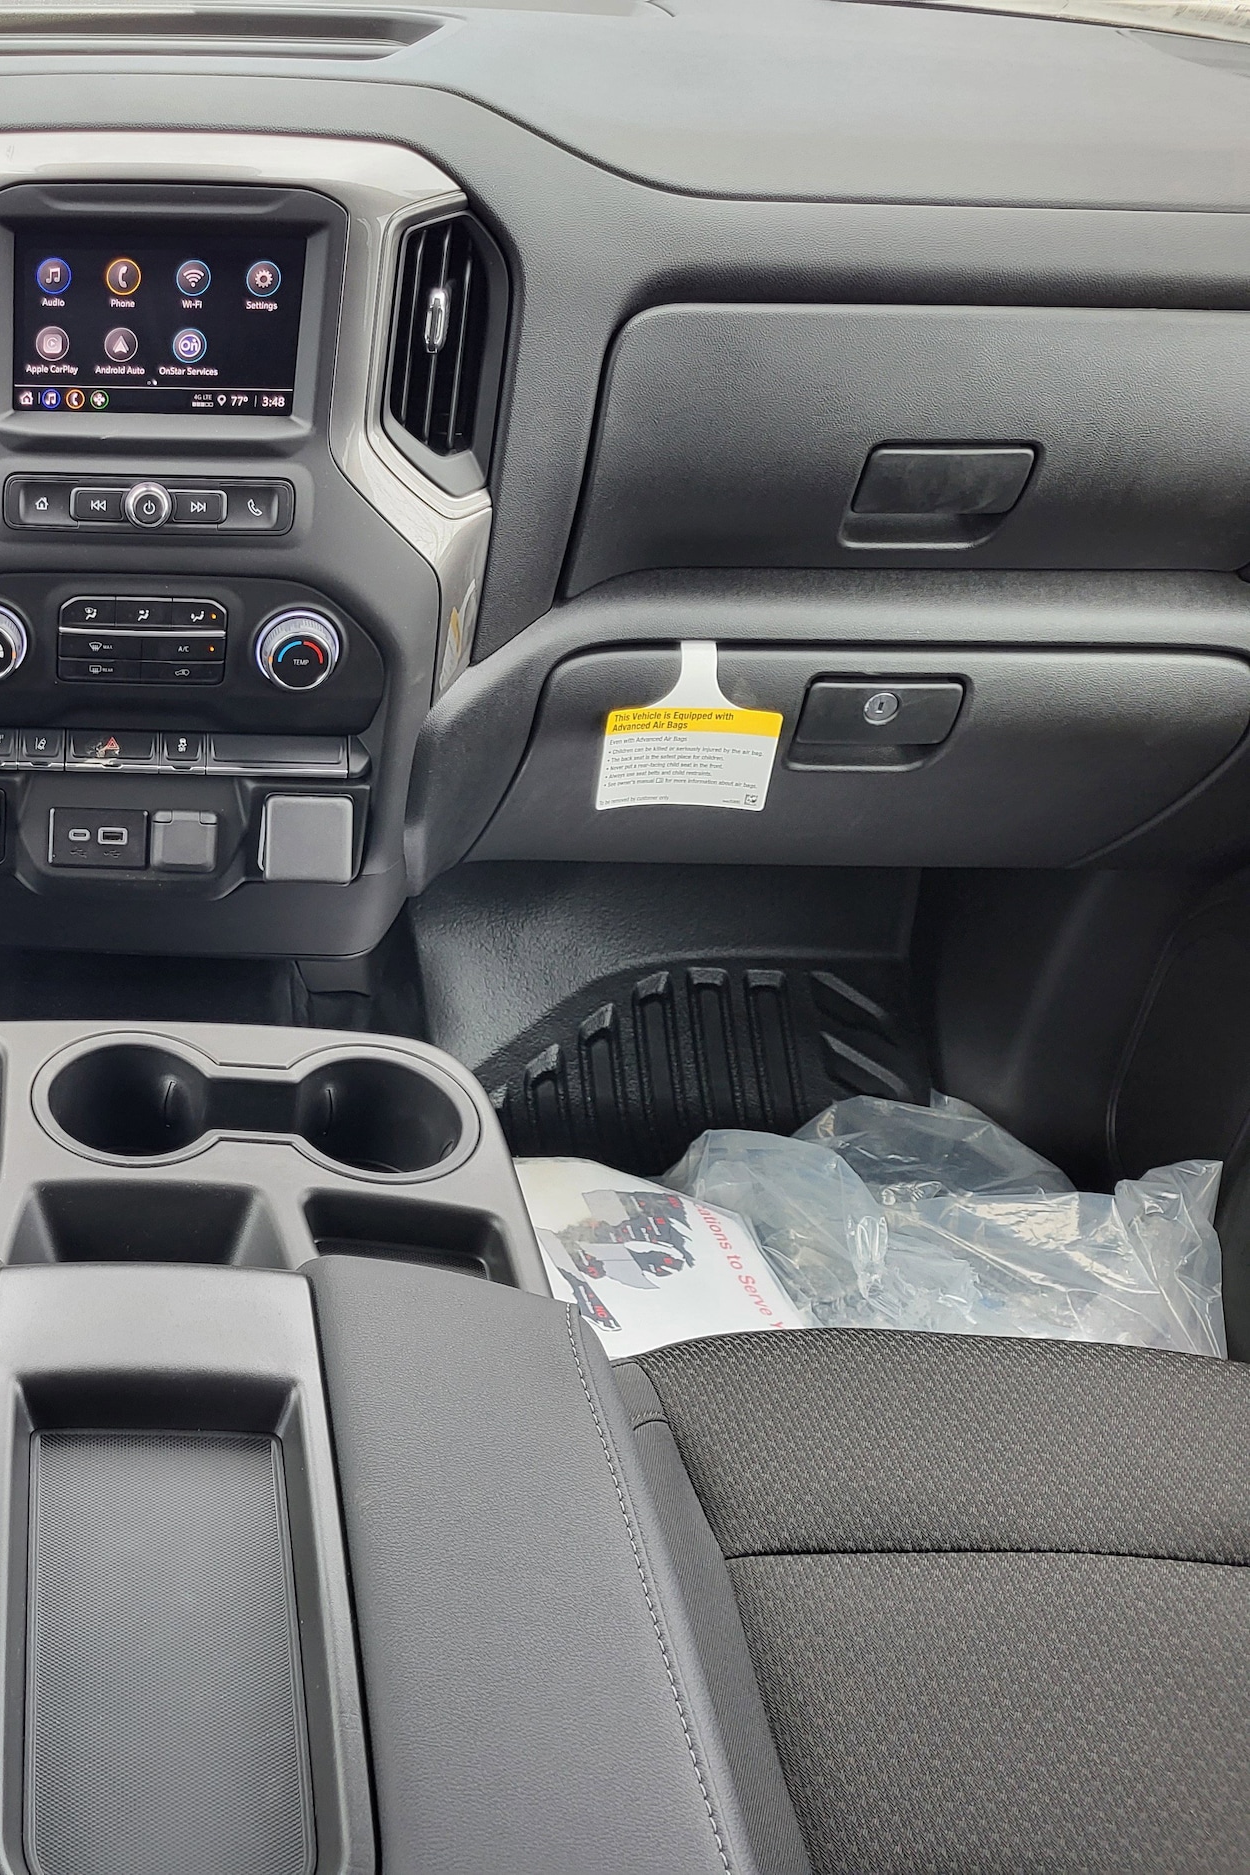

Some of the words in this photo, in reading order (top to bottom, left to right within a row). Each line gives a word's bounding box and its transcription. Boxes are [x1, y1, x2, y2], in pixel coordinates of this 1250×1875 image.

[42, 298, 65, 307] Audio
[110, 299, 135, 308] Phone
[182, 300, 203, 309] Wi-Fi
[246, 301, 278, 311] Settings
[26, 365, 49, 375] Apple
[50, 365, 78, 376] CarPlay
[95, 366, 125, 375] Android
[126, 366, 145, 375] Auto
[159, 367, 186, 376] OnStar
[187, 367, 218, 376] Services
[262, 396, 285, 407] 3:48
[615, 714, 630, 722] This
[632, 712, 662, 720] Vehicle
[664, 712, 671, 720] is
[674, 712, 713, 721] Equipped
[715, 712, 734, 720] with
[612, 722, 651, 732] Advanced
[652, 721, 664, 729] Air
[667, 721, 688, 730] Bags
[727, 1254, 743, 1270] to
[738, 1275, 773, 1316] Serve
